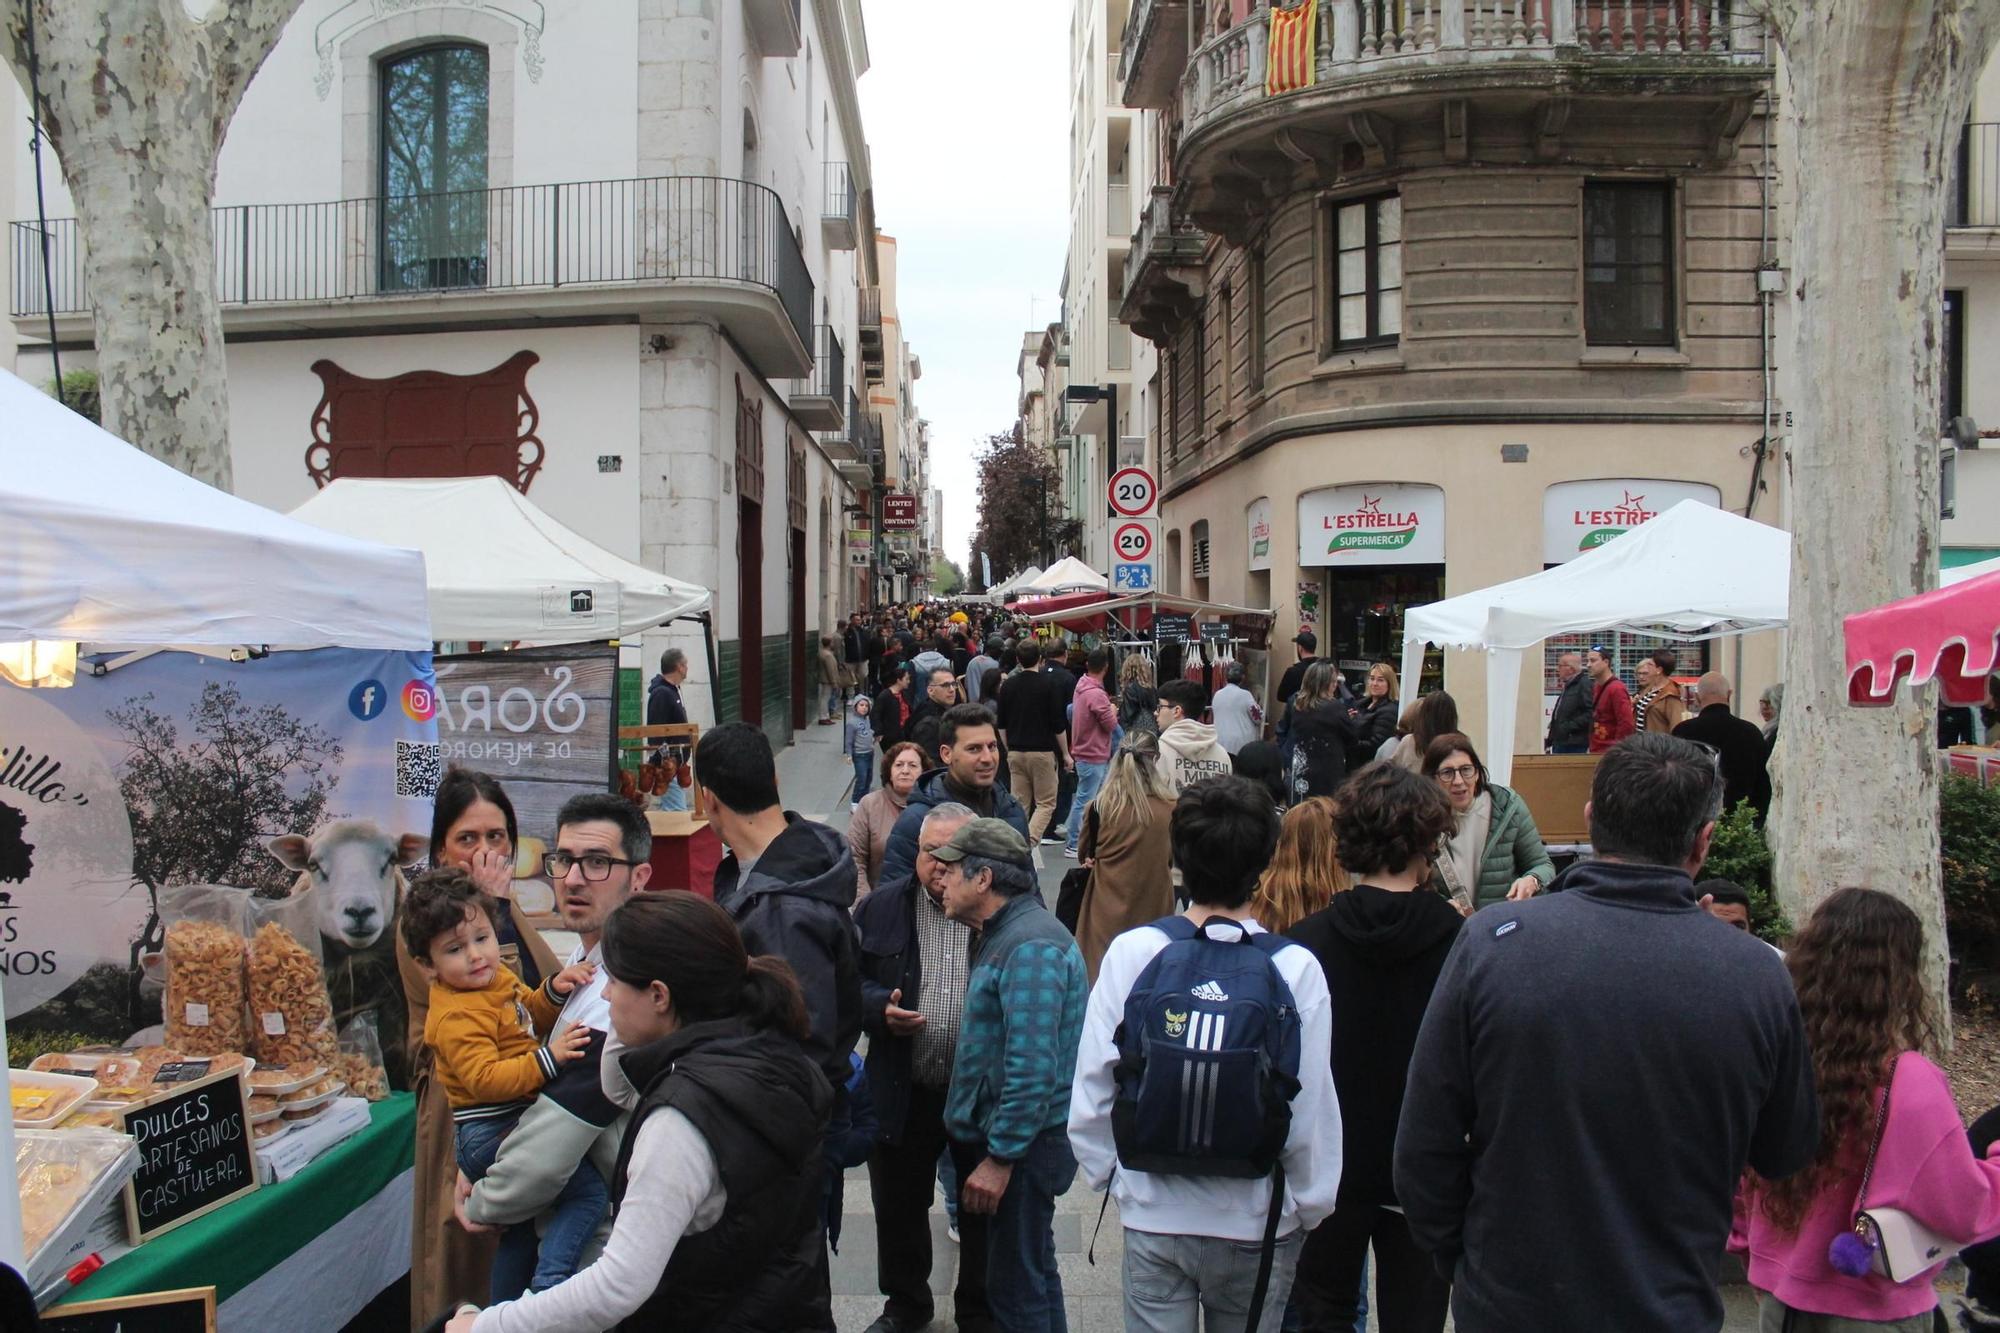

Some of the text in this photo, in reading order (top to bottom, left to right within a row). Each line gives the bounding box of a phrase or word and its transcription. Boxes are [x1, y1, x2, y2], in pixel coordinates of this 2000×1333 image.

[1119, 484, 1146, 500] 20
[1324, 512, 1419, 529] L'ESTRELLA
[1121, 535, 1146, 549] 20
[1340, 535, 1405, 546] SUPERMERCAT
[1594, 534, 1620, 544] SUP
[1184, 769, 1216, 783] MIN
[1191, 987, 1229, 1001] adidas
[133, 1094, 210, 1144] DULCES
[135, 1112, 241, 1179] ARTESANOS
[178, 1159, 192, 1174] DE
